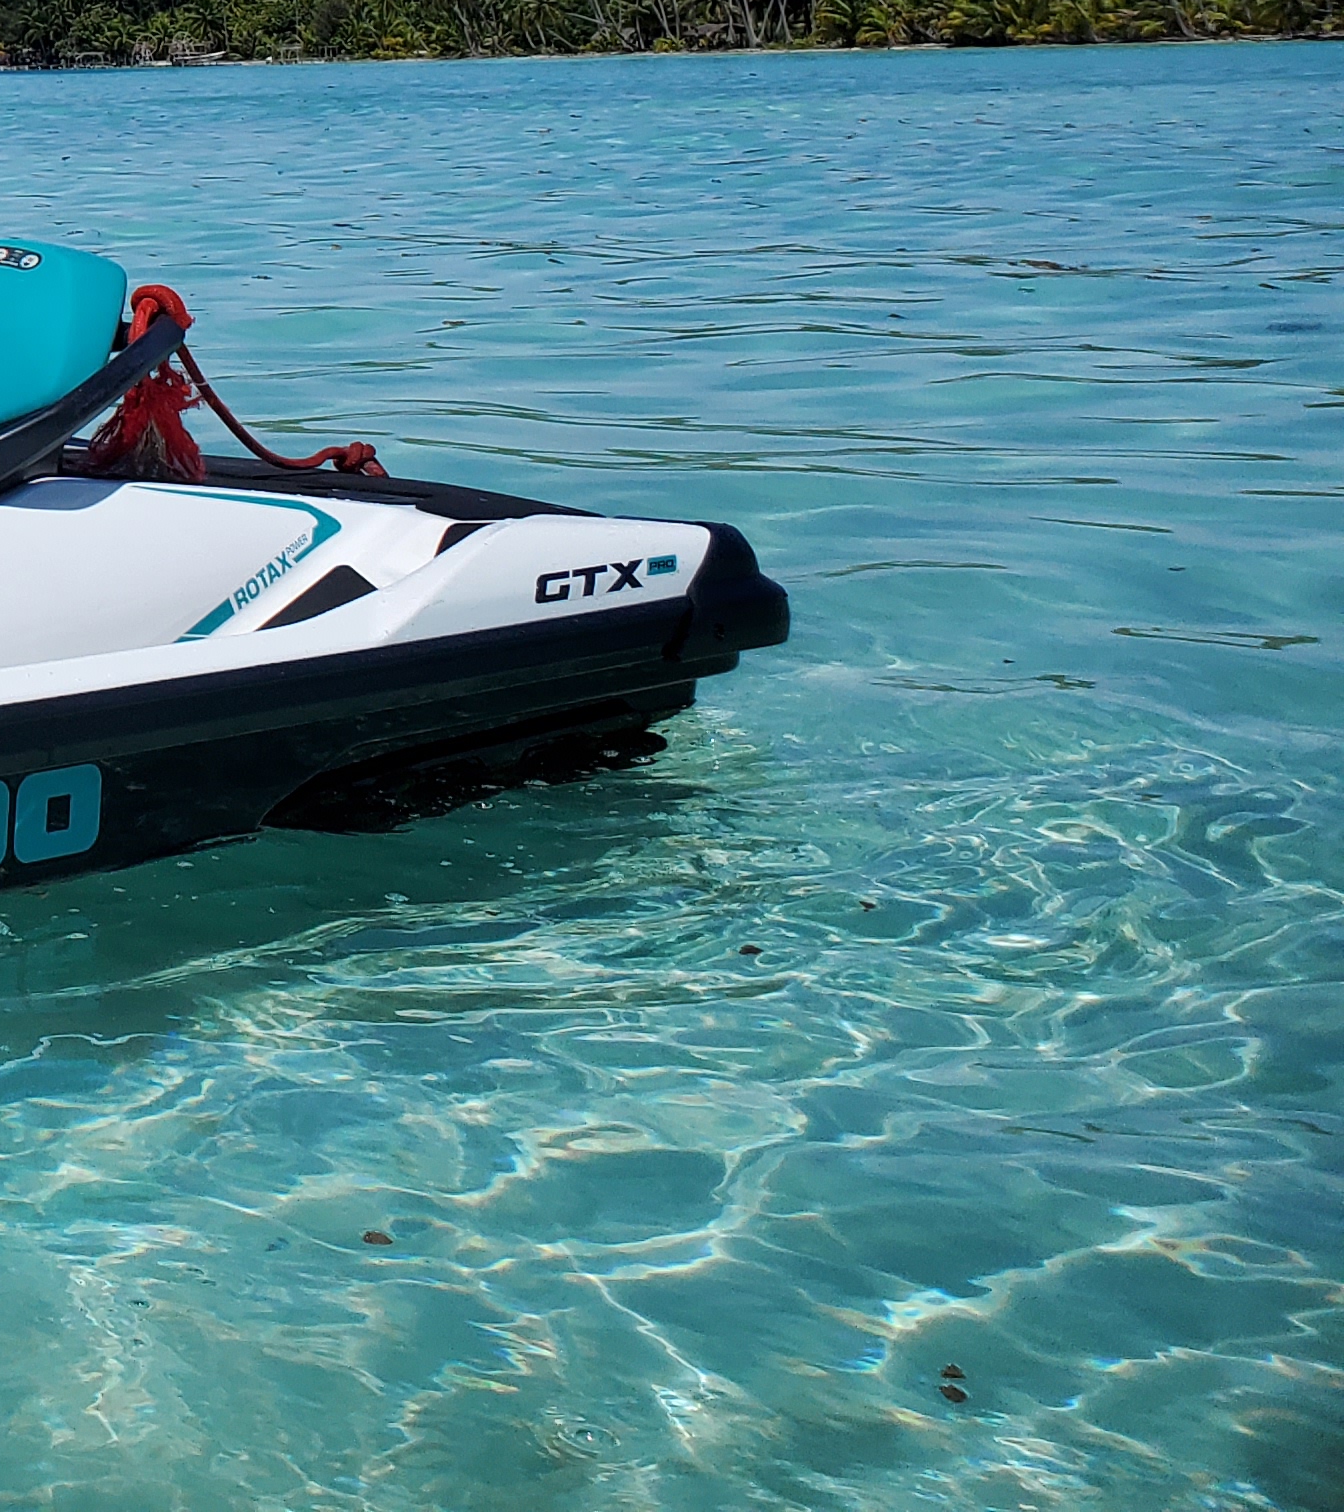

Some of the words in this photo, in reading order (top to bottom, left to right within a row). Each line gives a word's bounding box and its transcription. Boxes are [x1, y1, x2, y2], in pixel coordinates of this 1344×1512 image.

[233, 550, 293, 610] ROTAX
[285, 533, 309, 557] POWER
[535, 558, 644, 604] GTX
[648, 558, 675, 572] PRO
